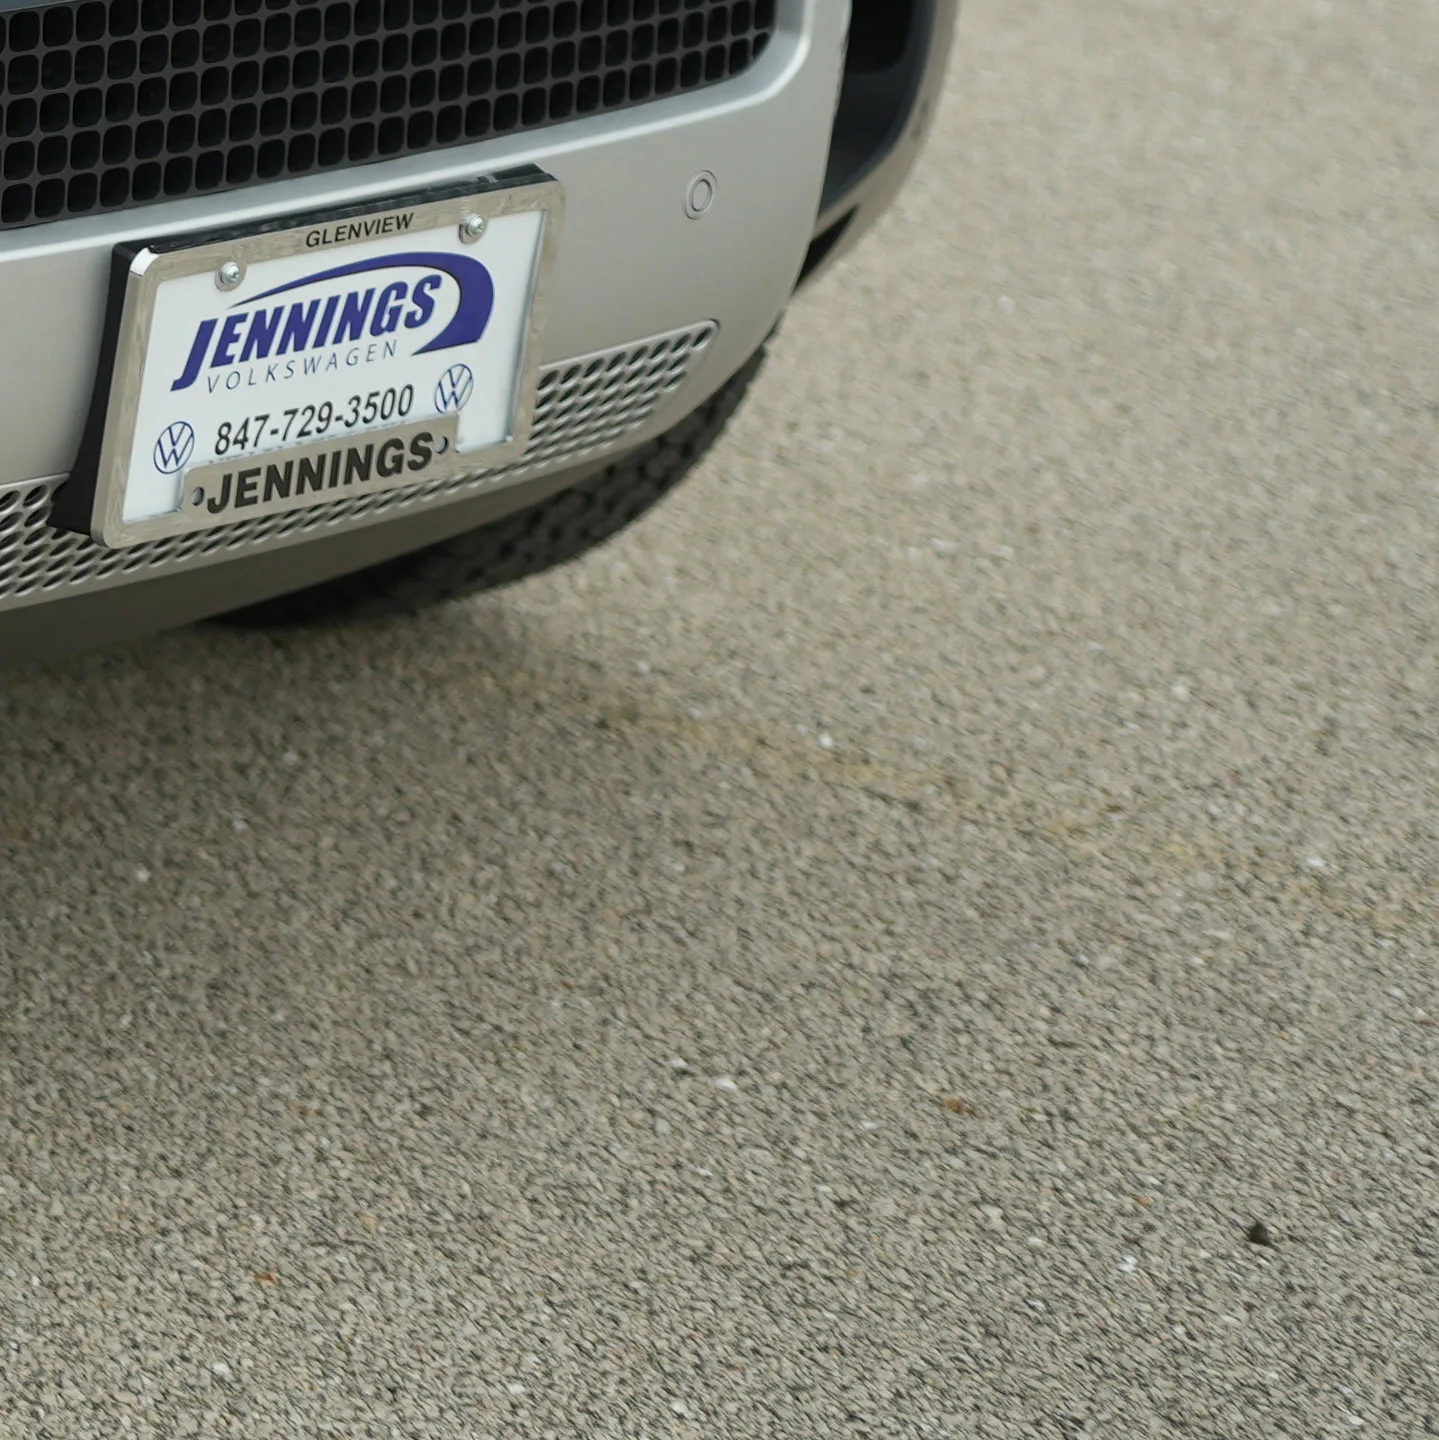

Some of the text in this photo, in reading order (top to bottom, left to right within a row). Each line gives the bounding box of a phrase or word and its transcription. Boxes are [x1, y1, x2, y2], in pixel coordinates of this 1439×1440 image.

[306, 212, 414, 248] GLENVIEW
[170, 274, 442, 392] JENNINGS
[207, 339, 397, 394] VOLKSWAGEN
[214, 383, 414, 456] 847-729-3500
[207, 431, 433, 514] JENNINGS
